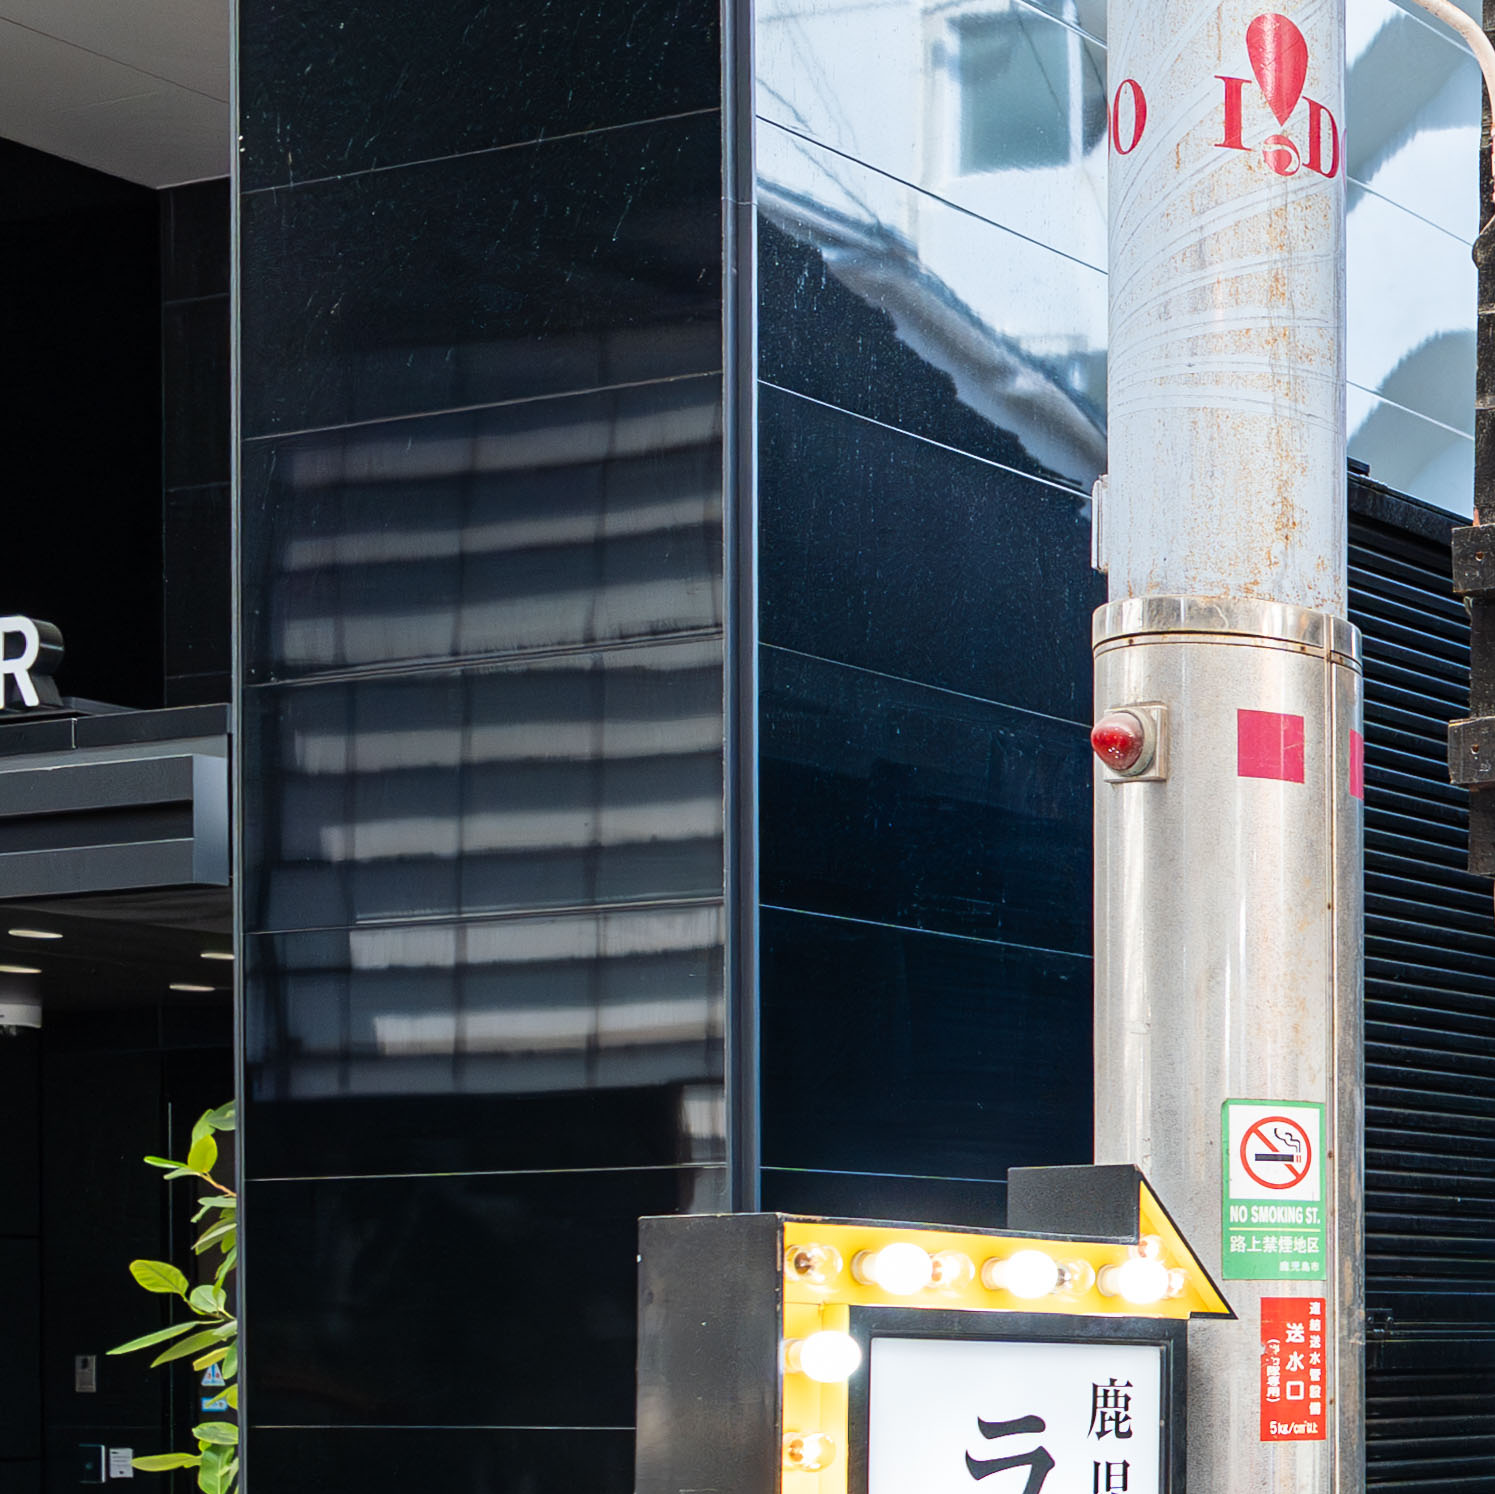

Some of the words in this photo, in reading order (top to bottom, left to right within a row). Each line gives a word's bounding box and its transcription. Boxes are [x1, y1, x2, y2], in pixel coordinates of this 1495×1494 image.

[1230, 1206, 1248, 1223] NO
[1251, 1206, 1303, 1223] SMOKING
[1306, 1207, 1320, 1224] ST.
[1230, 1235, 1319, 1253] 路上禁煙地区
[1285, 1322, 1305, 1400] 送水口
